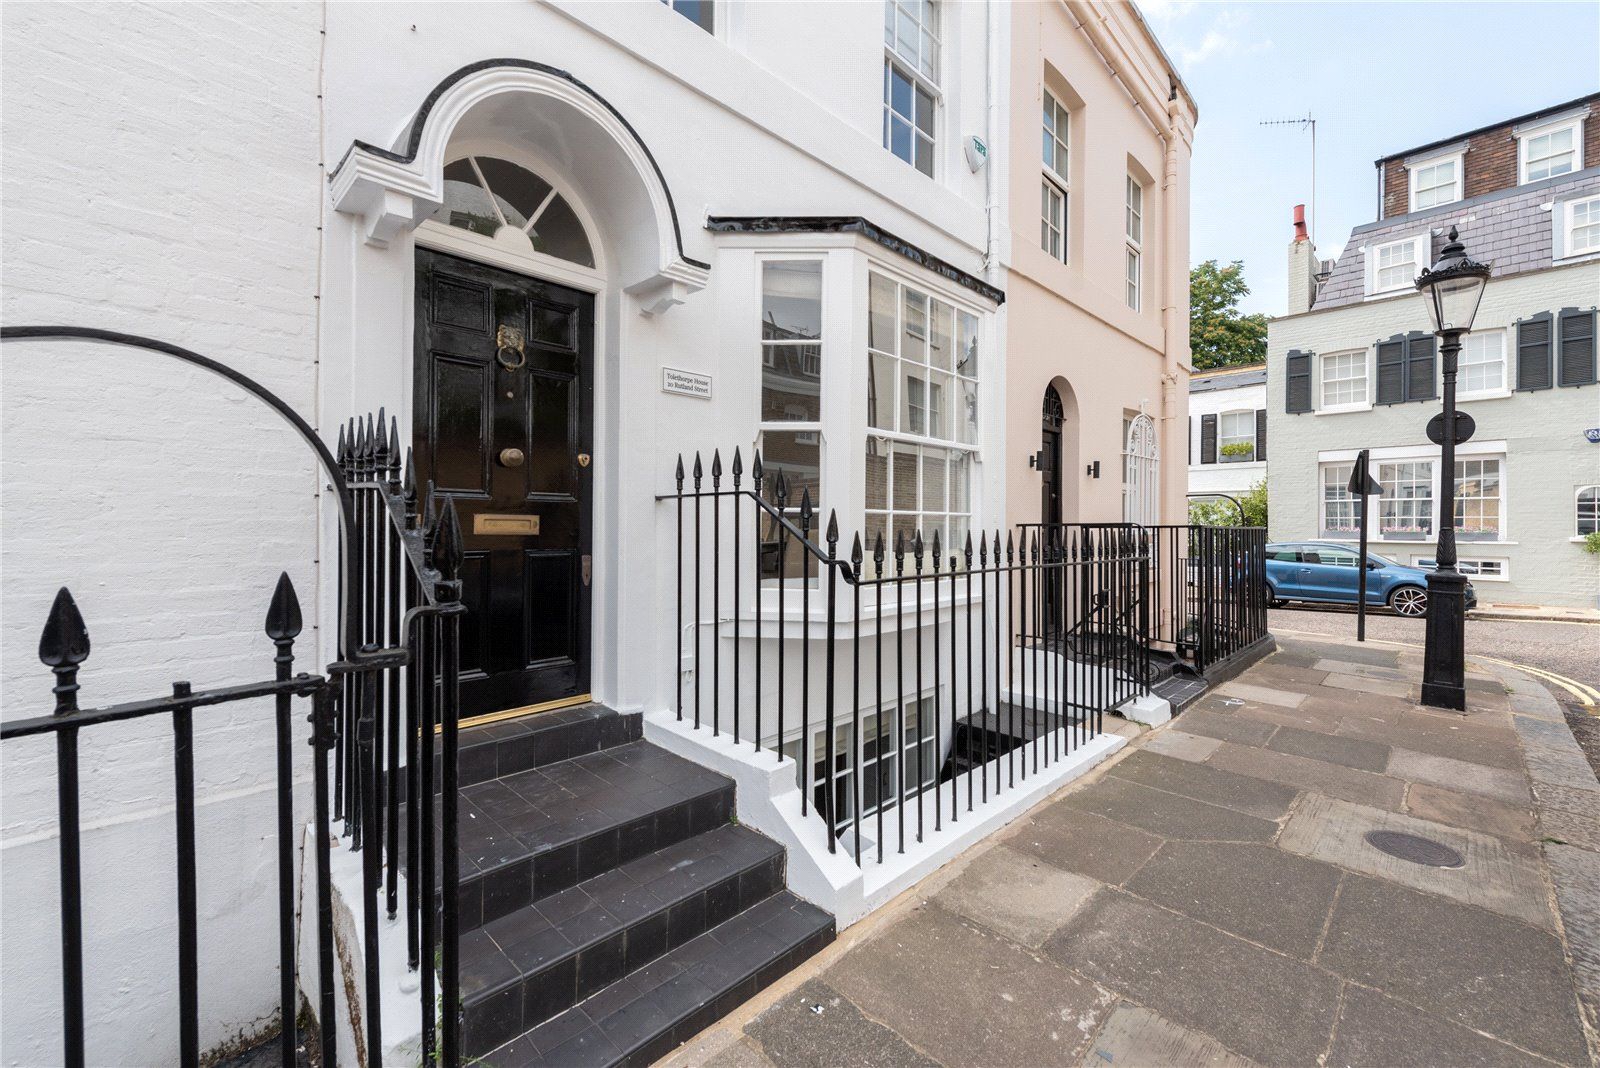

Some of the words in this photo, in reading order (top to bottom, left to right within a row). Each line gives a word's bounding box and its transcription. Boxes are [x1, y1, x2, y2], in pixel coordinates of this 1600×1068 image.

[694, 378, 708, 386] House
[674, 382, 693, 391] Rutland
[694, 385, 708, 393] Street
